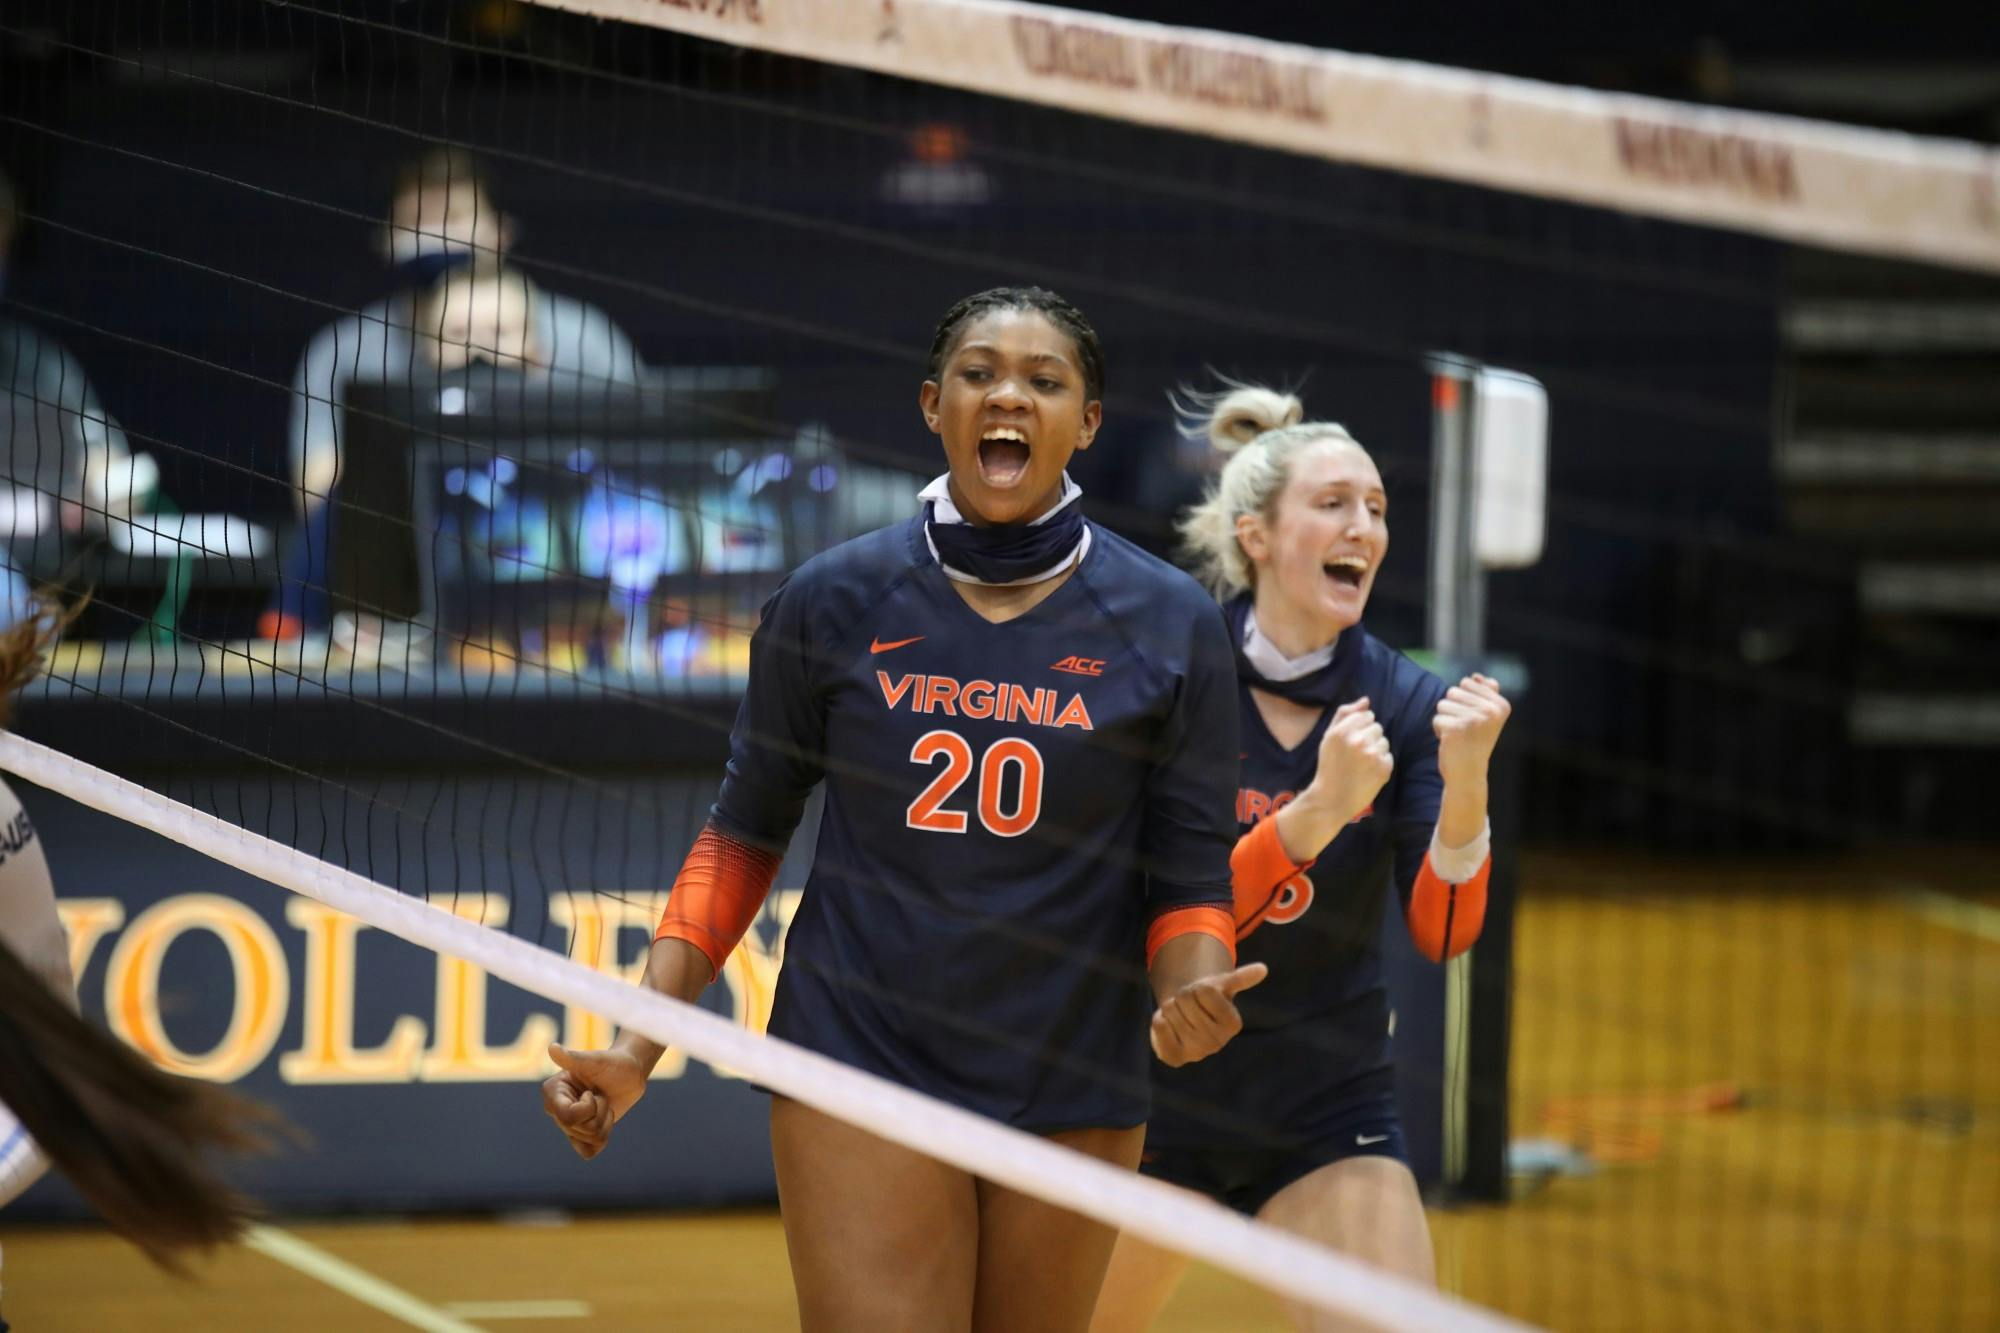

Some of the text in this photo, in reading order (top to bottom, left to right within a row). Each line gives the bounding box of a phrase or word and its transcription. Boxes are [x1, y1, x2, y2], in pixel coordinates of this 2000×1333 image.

[1053, 655, 1106, 675] ACC
[876, 670, 1094, 730] VIRGINIA
[906, 729, 1044, 838] 20
